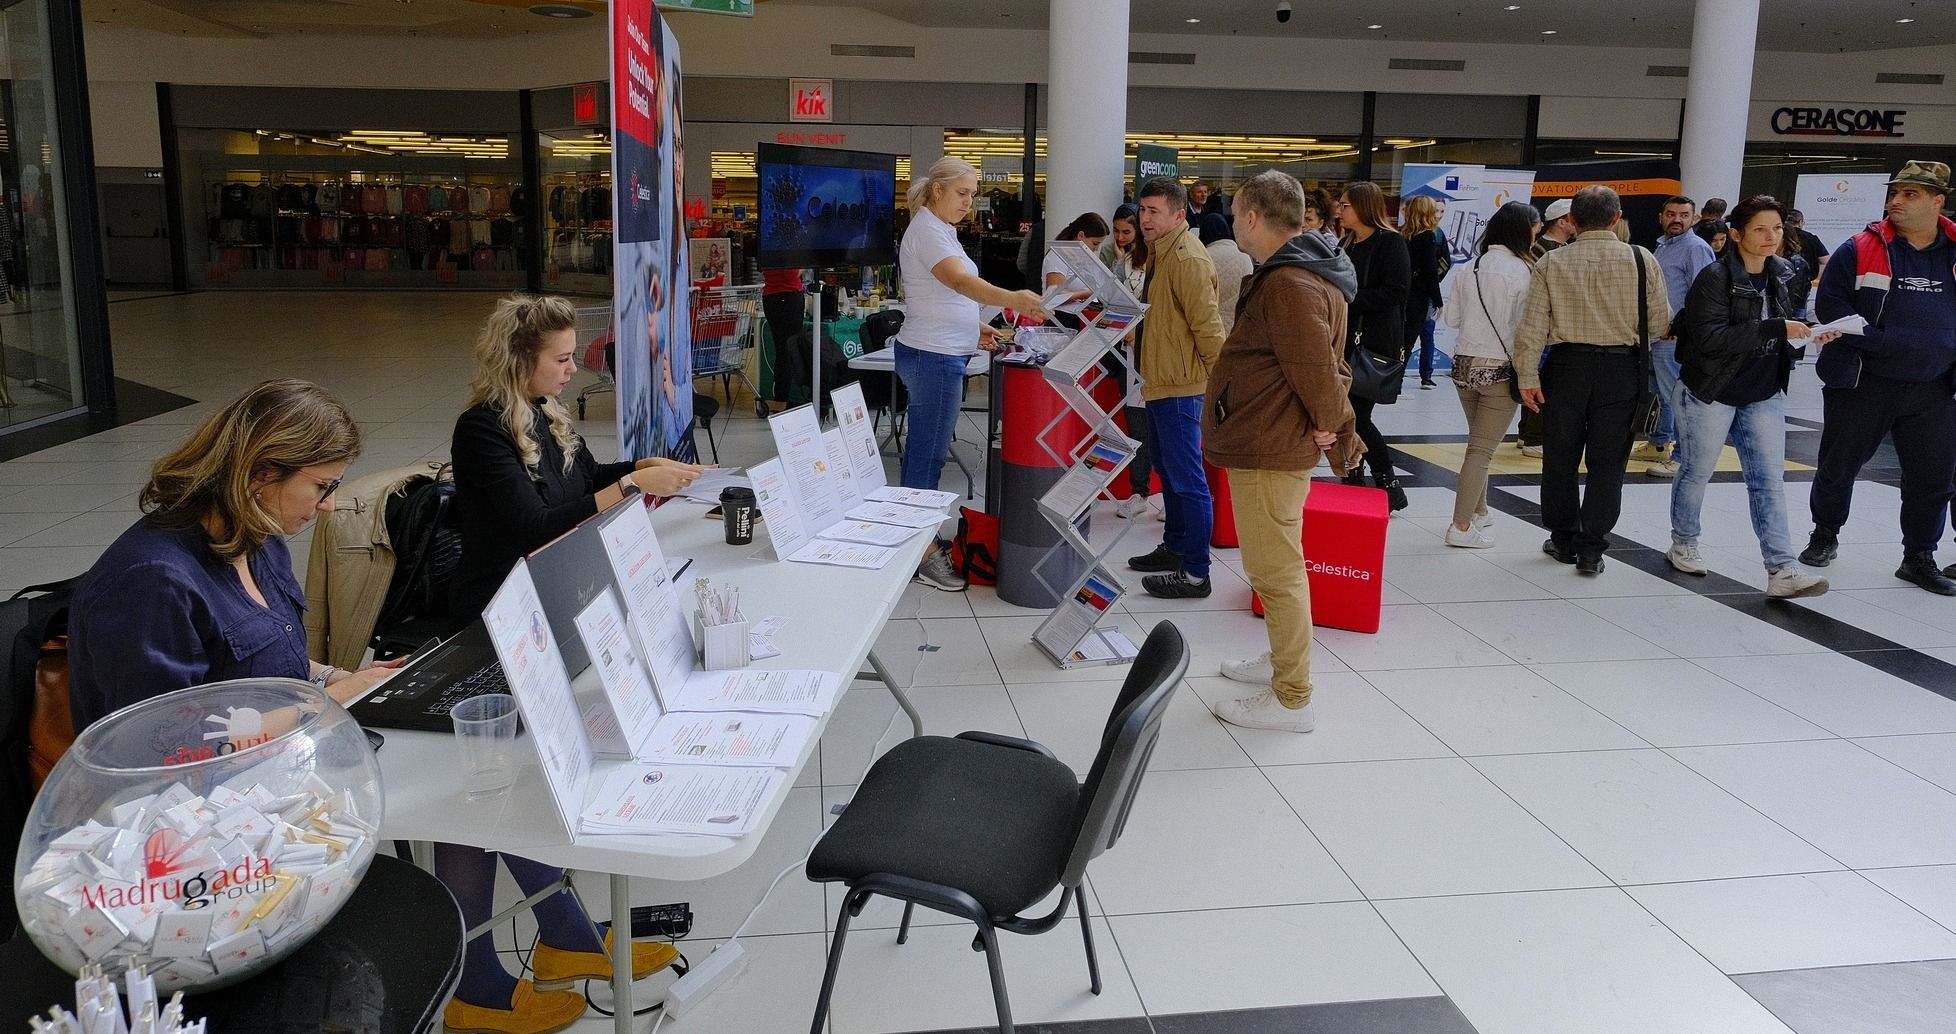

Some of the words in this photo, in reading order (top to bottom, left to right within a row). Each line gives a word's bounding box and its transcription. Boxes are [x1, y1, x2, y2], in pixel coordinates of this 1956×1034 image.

[627, 14, 635, 38] Join
[641, 32, 650, 56] Team
[628, 47, 644, 86] Unlock
[644, 64, 654, 95] Your
[796, 86, 827, 116] kik
[776, 132, 804, 145] BUN
[808, 132, 847, 146] VENIT
[1140, 160, 1177, 178] greencorp
[637, 183, 651, 201] Celestica
[740, 506, 751, 539] Pellini
[1303, 559, 1371, 581] Celestica
[80, 856, 272, 912] Madrugada
